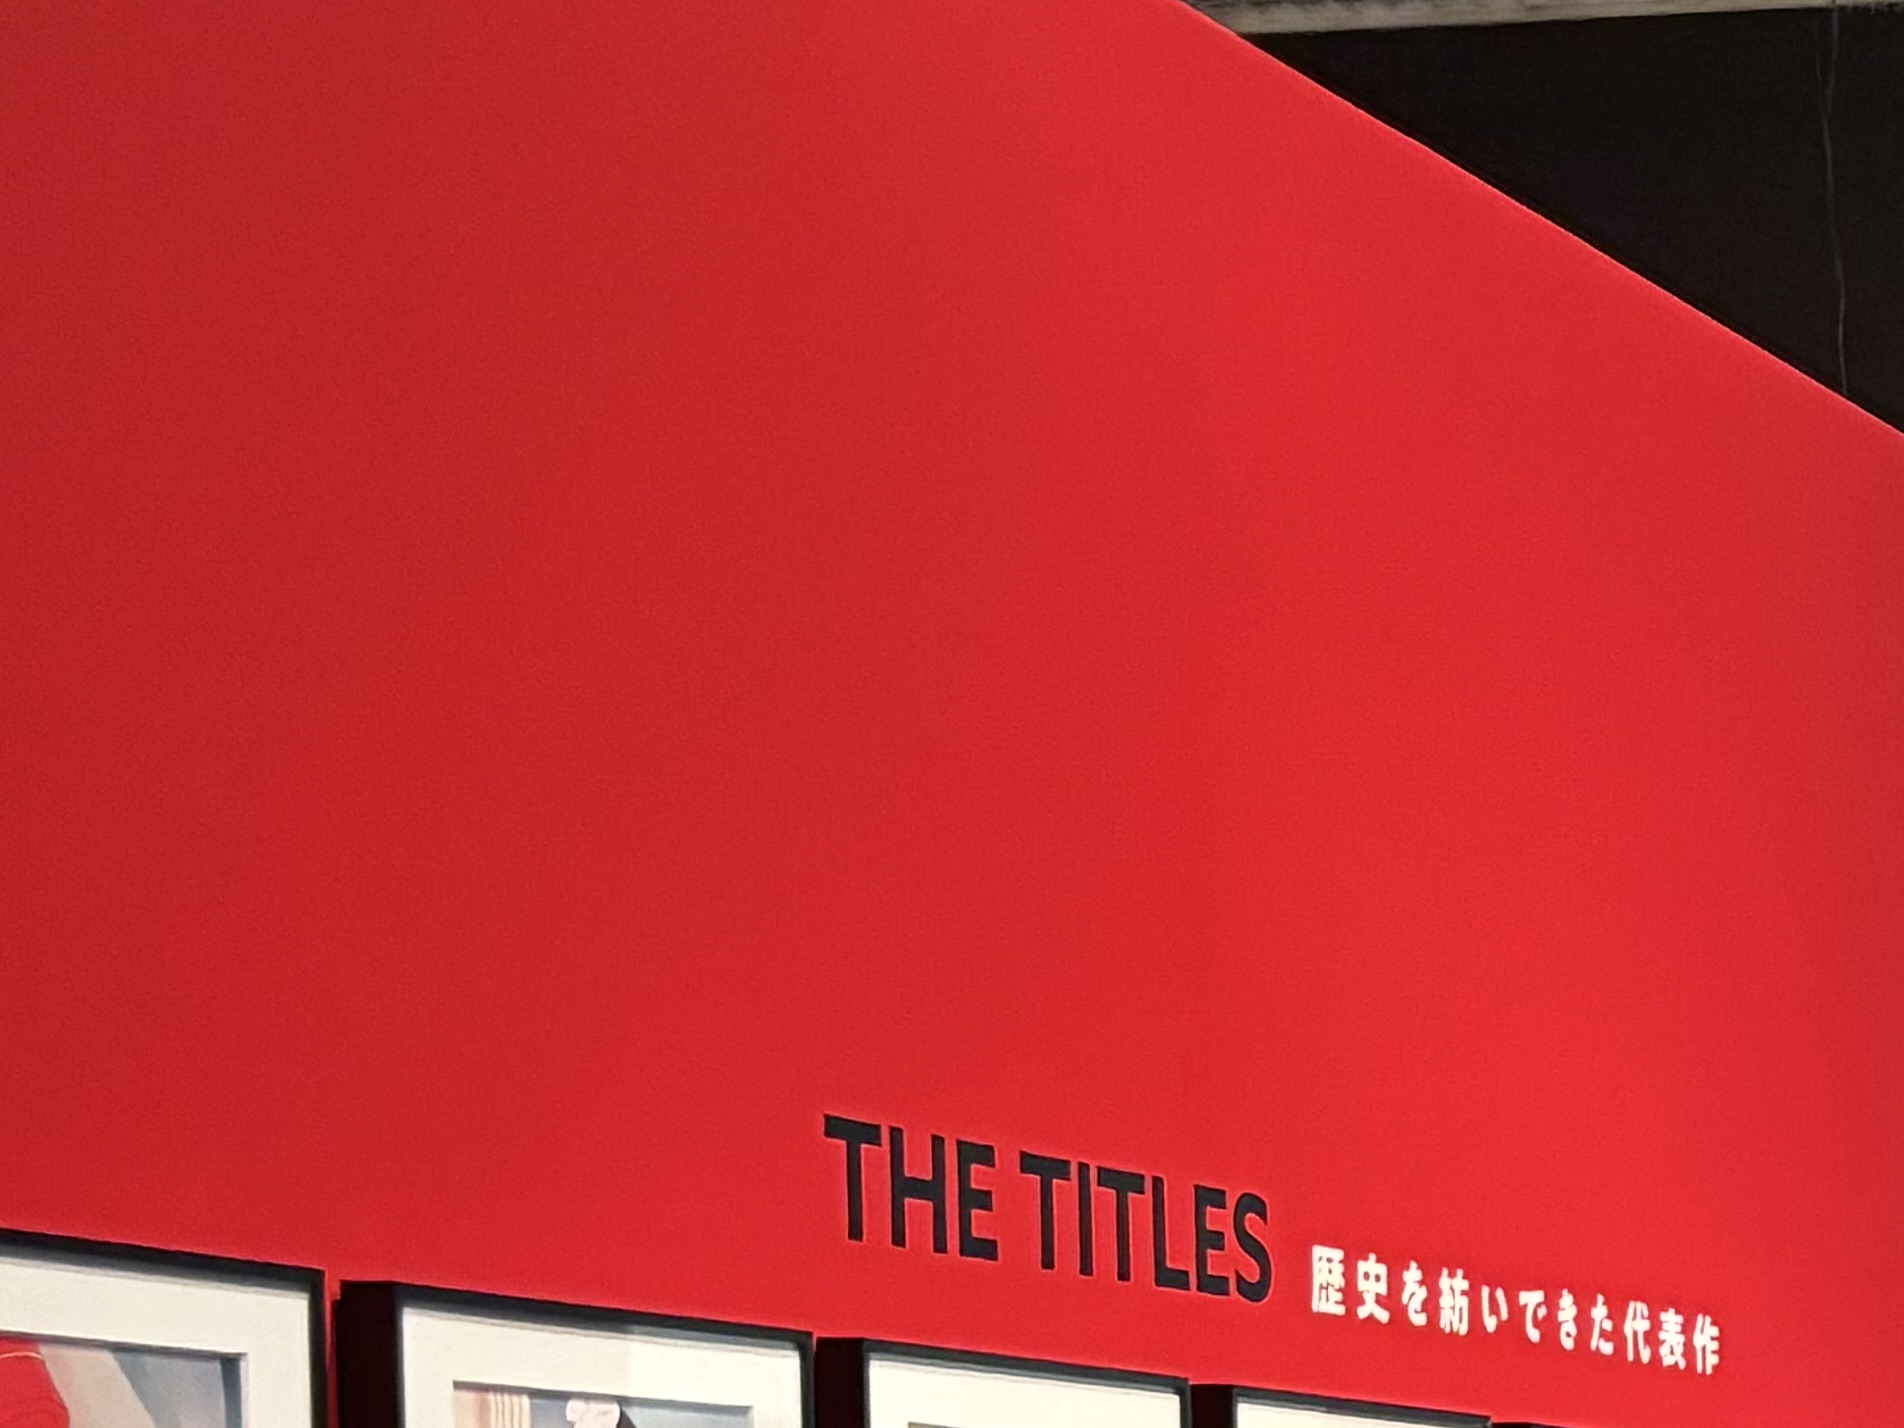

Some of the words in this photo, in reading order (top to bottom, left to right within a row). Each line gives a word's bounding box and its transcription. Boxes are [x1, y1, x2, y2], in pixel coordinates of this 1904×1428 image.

[824, 1114, 998, 1263] THE
[1019, 1150, 1273, 1303] TITLES
[1311, 1245, 1721, 1377] 歴史を紡いできた代表作
